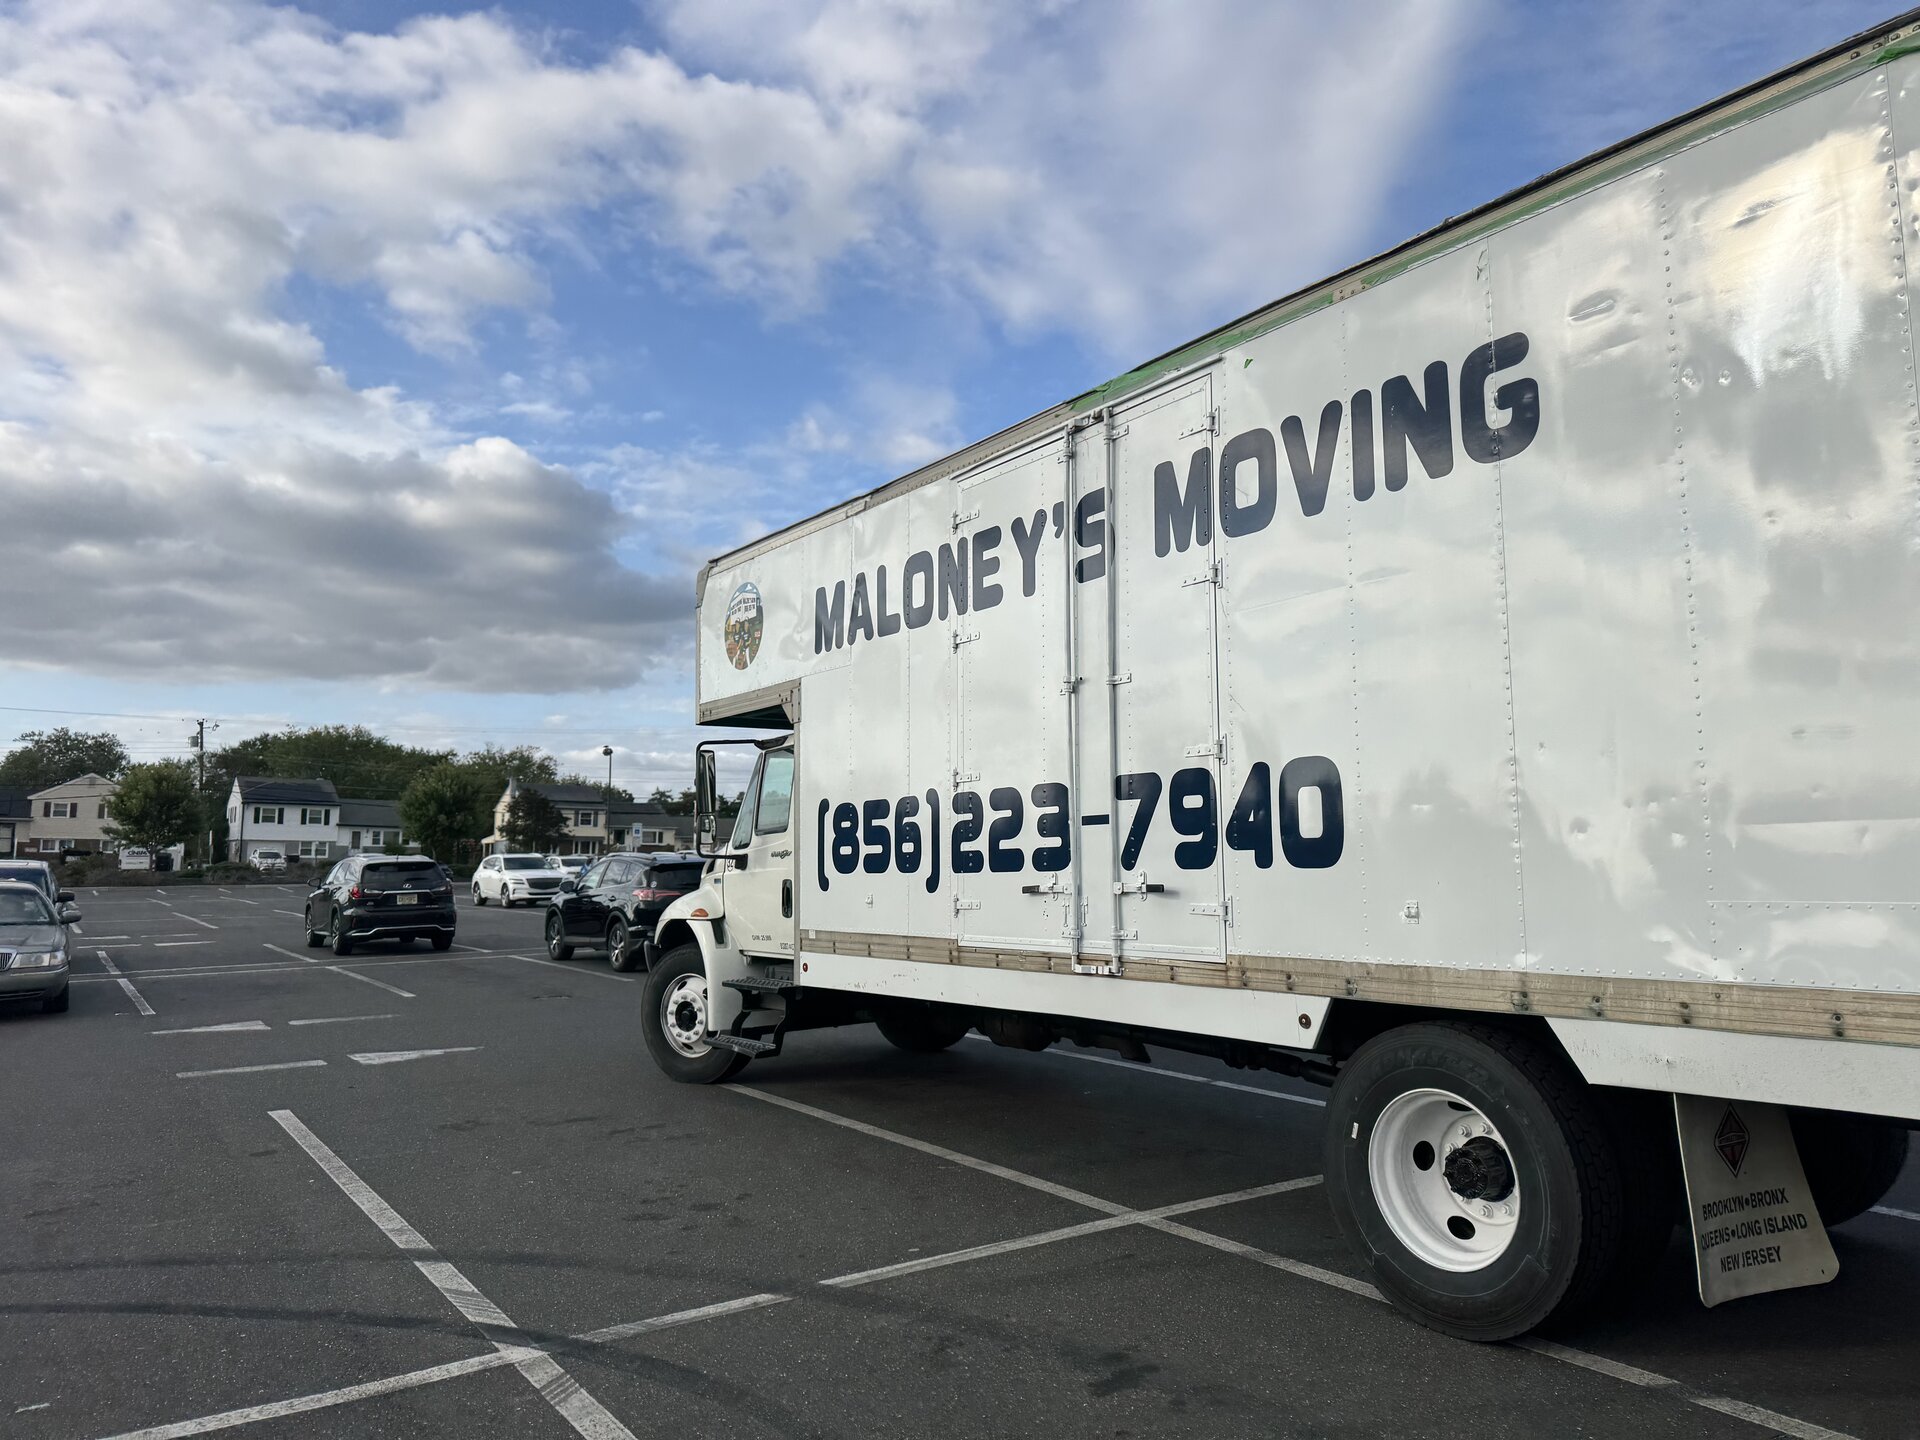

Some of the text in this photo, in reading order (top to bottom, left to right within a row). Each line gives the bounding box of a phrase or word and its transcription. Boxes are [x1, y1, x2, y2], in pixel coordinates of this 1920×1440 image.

[814, 331, 1540, 654] MALONEY'S MOVING
[1763, 1213, 1808, 1235] ISLAND
[1720, 1246, 1782, 1273] NEW JERSEY
